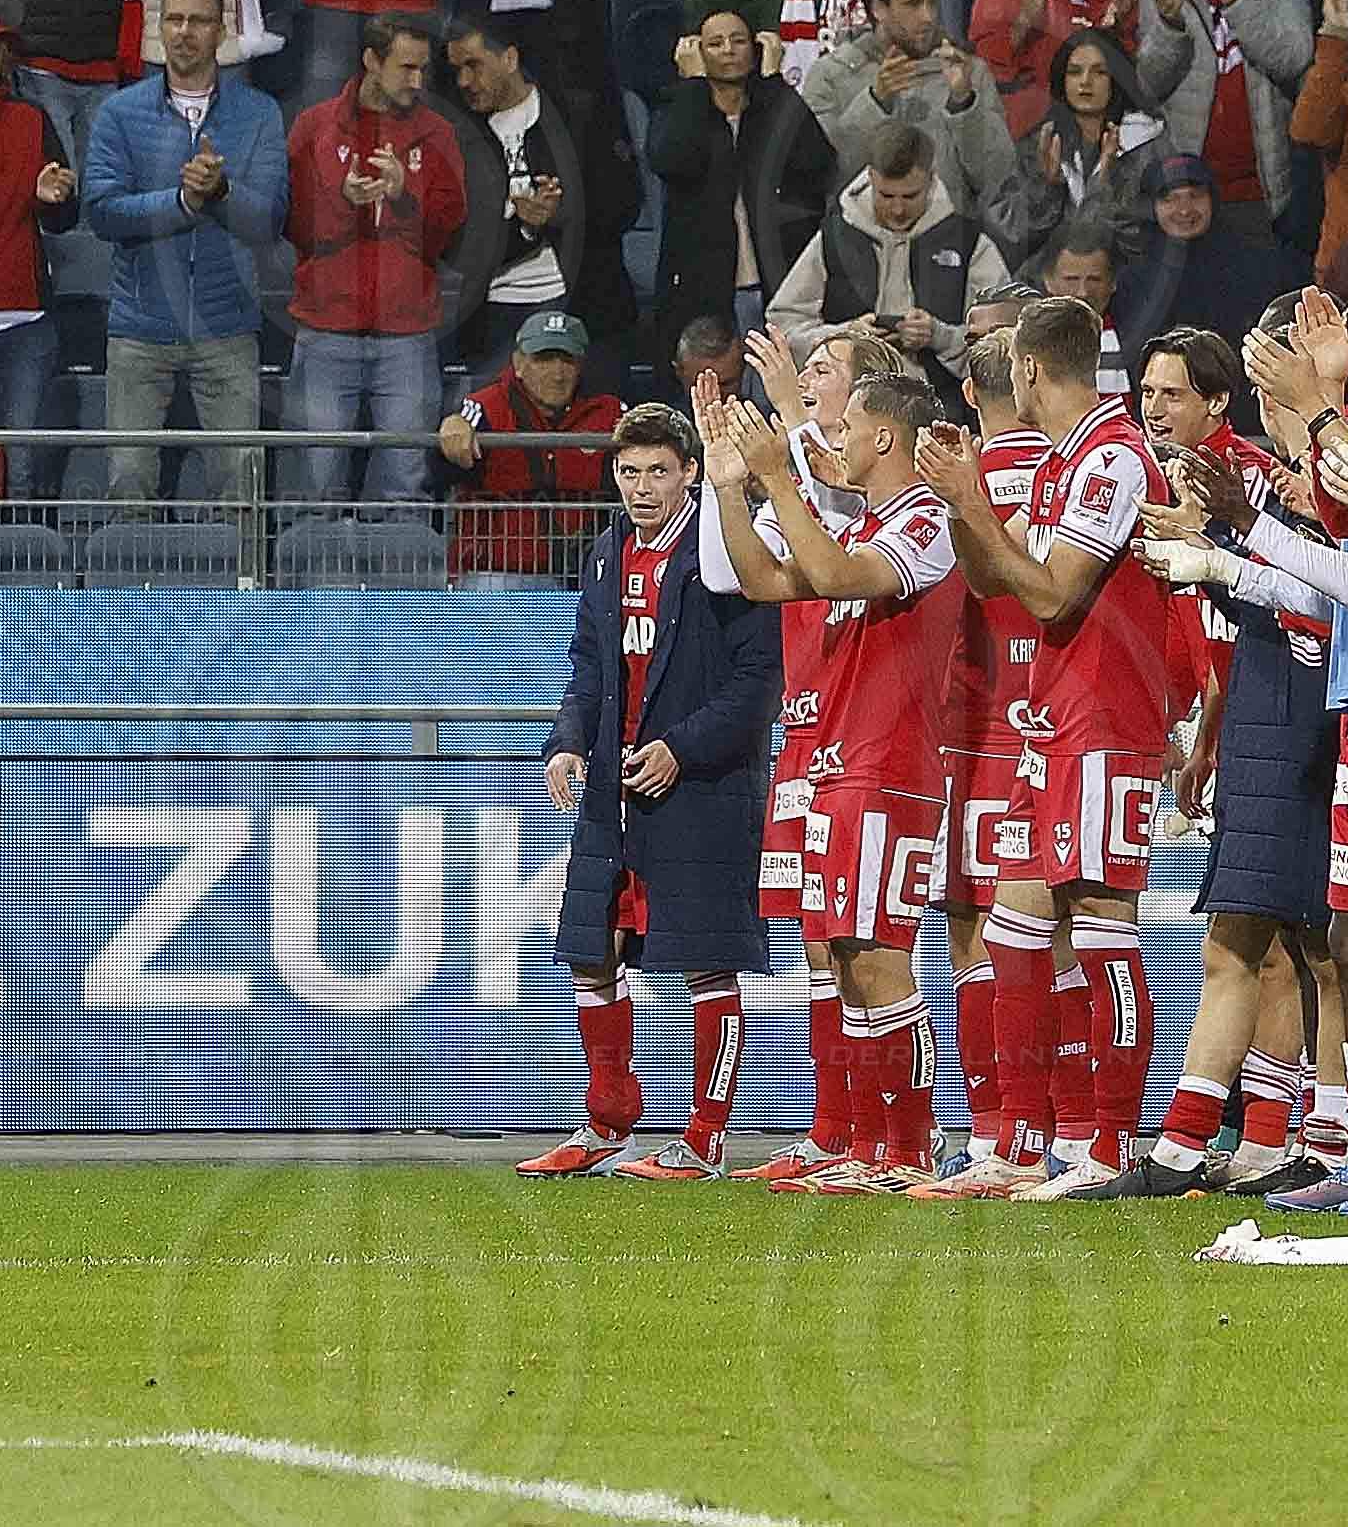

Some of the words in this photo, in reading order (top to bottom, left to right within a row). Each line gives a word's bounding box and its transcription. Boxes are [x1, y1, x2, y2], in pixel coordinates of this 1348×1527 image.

[1054, 822, 1072, 839] 15
[836, 876, 847, 894] 8
[1120, 968, 1134, 1018] ENERGIE
[1125, 1017, 1136, 1045] GRAZ
